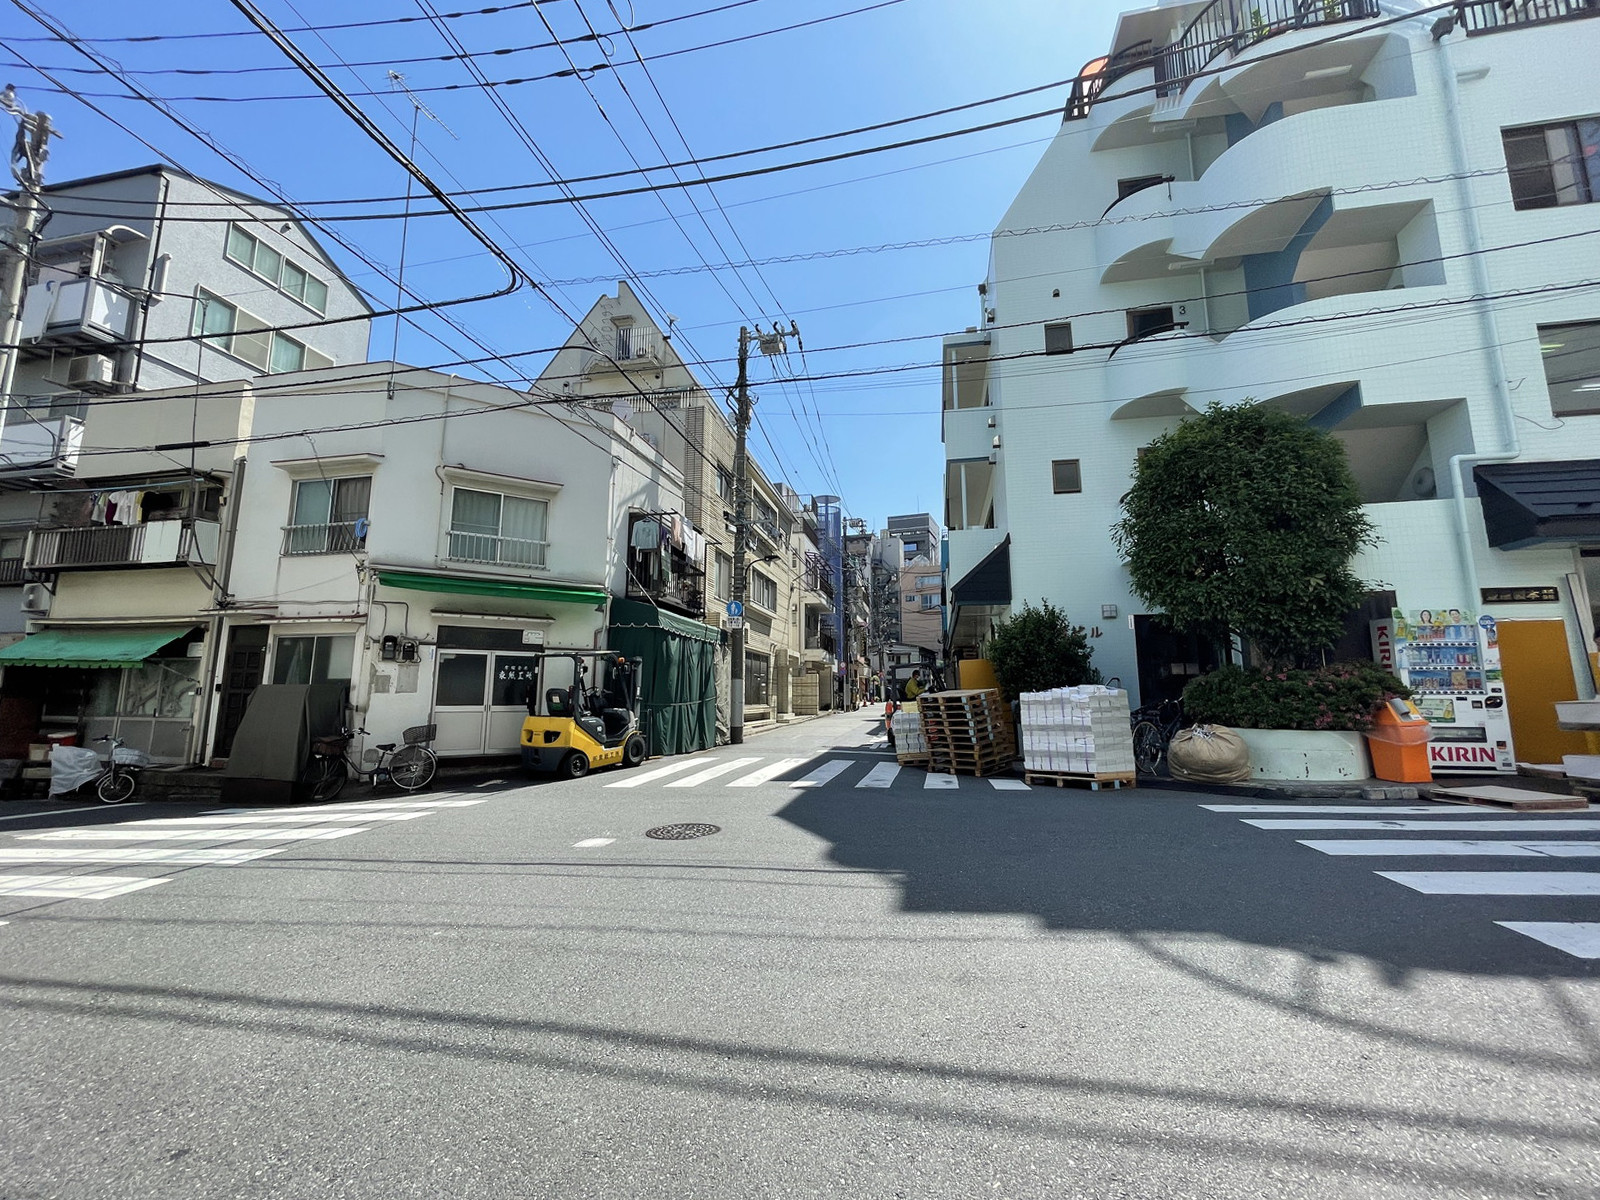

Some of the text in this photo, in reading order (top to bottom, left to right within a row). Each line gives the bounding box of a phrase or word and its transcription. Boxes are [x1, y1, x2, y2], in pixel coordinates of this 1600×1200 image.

[1179, 306, 1186, 315] 3
[1376, 625, 1393, 676] KIRI
[1430, 746, 1496, 762] KIRIN
